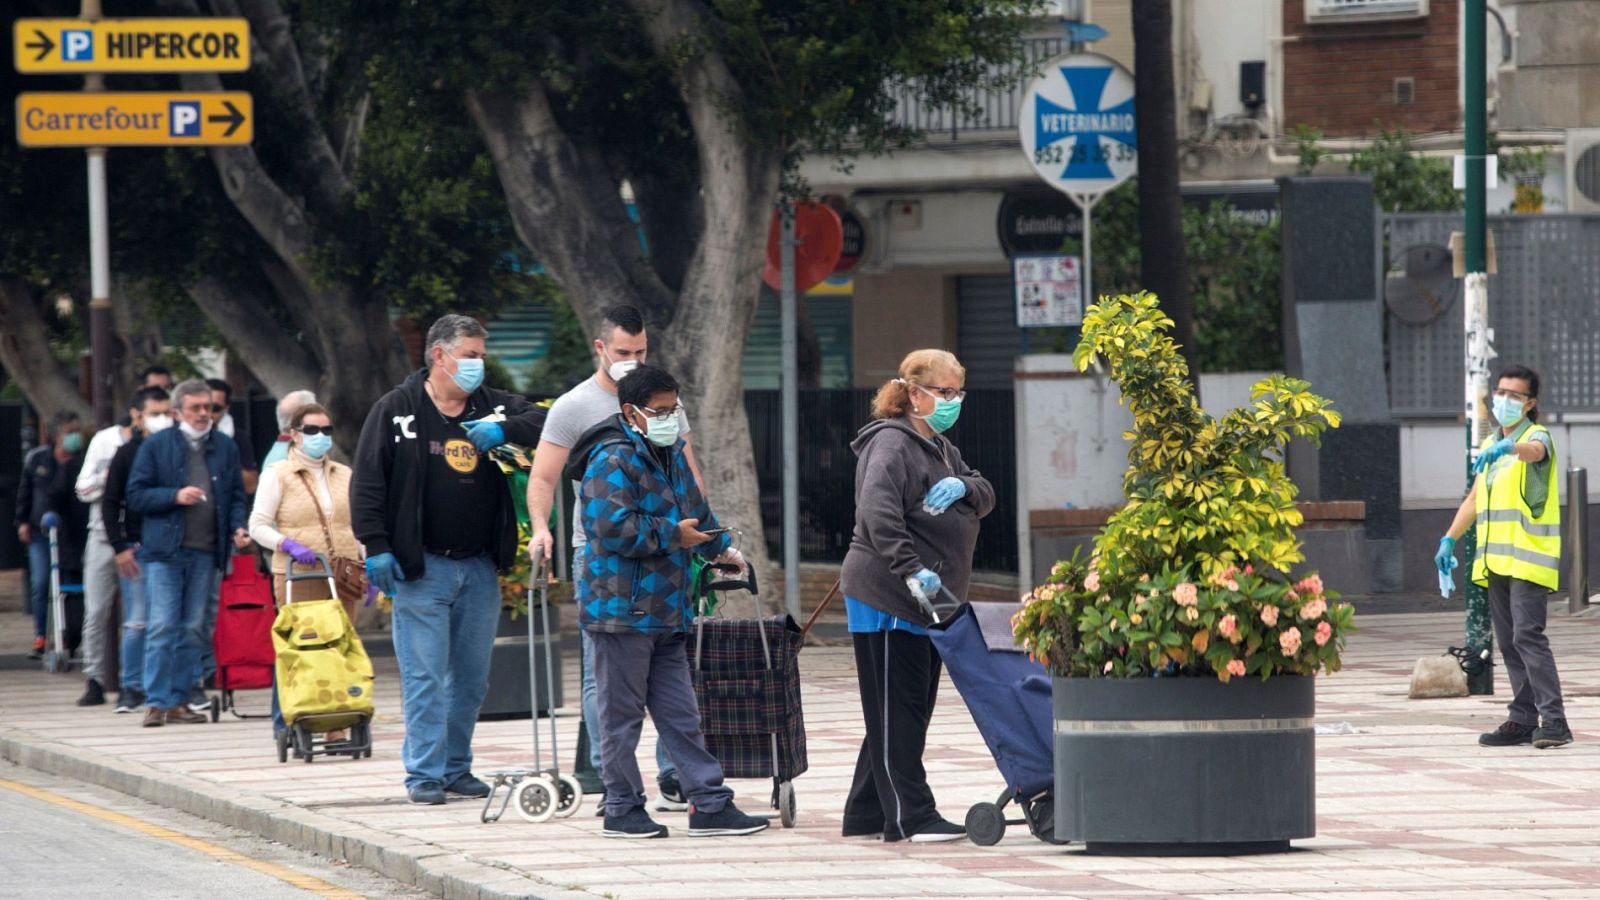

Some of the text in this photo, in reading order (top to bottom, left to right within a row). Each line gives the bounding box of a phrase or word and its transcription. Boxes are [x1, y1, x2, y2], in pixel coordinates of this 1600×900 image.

[66, 32, 241, 60] P HIPERCOR
[25, 105, 198, 134] Carrefour P
[1040, 113, 1135, 133] VETERINARIO
[1034, 144, 1063, 164] 952
[429, 440, 483, 460] Hard Ro
